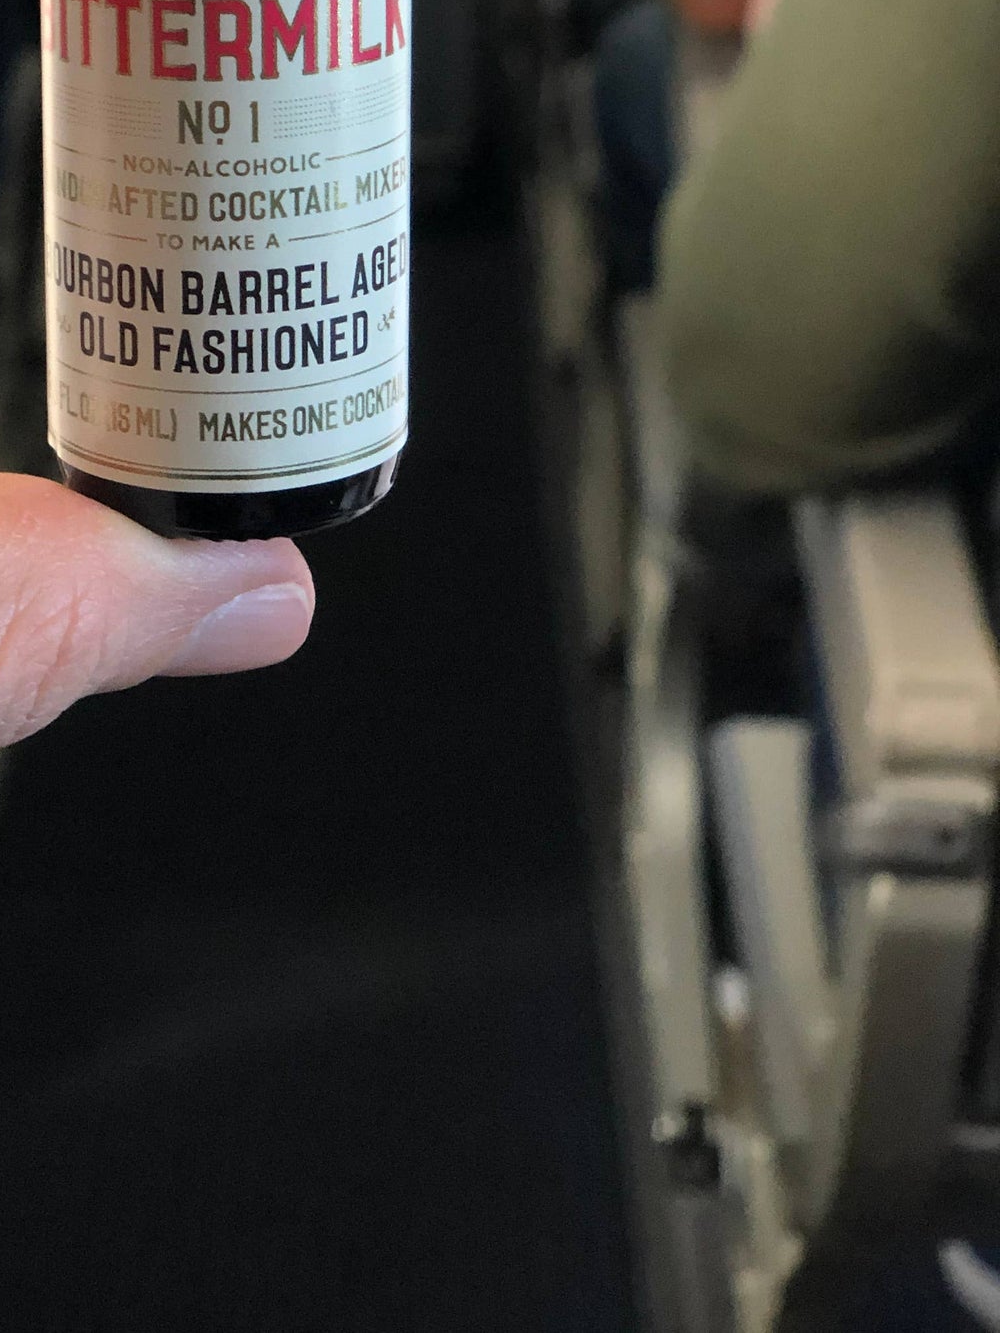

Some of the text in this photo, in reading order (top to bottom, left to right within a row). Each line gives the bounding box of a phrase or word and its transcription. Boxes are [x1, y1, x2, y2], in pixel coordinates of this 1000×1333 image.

[249, 100, 261, 144] 1
[122, 152, 322, 178] NON-ALCOHOLIC
[208, 180, 349, 222] COCKTAIL
[156, 233, 281, 252] TO MAKE A
[54, 231, 407, 316] OURBON BARREL AGED
[79, 309, 369, 374] OLD FASHIONED
[198, 409, 288, 443] MAKES
[292, 399, 339, 437] ONE
